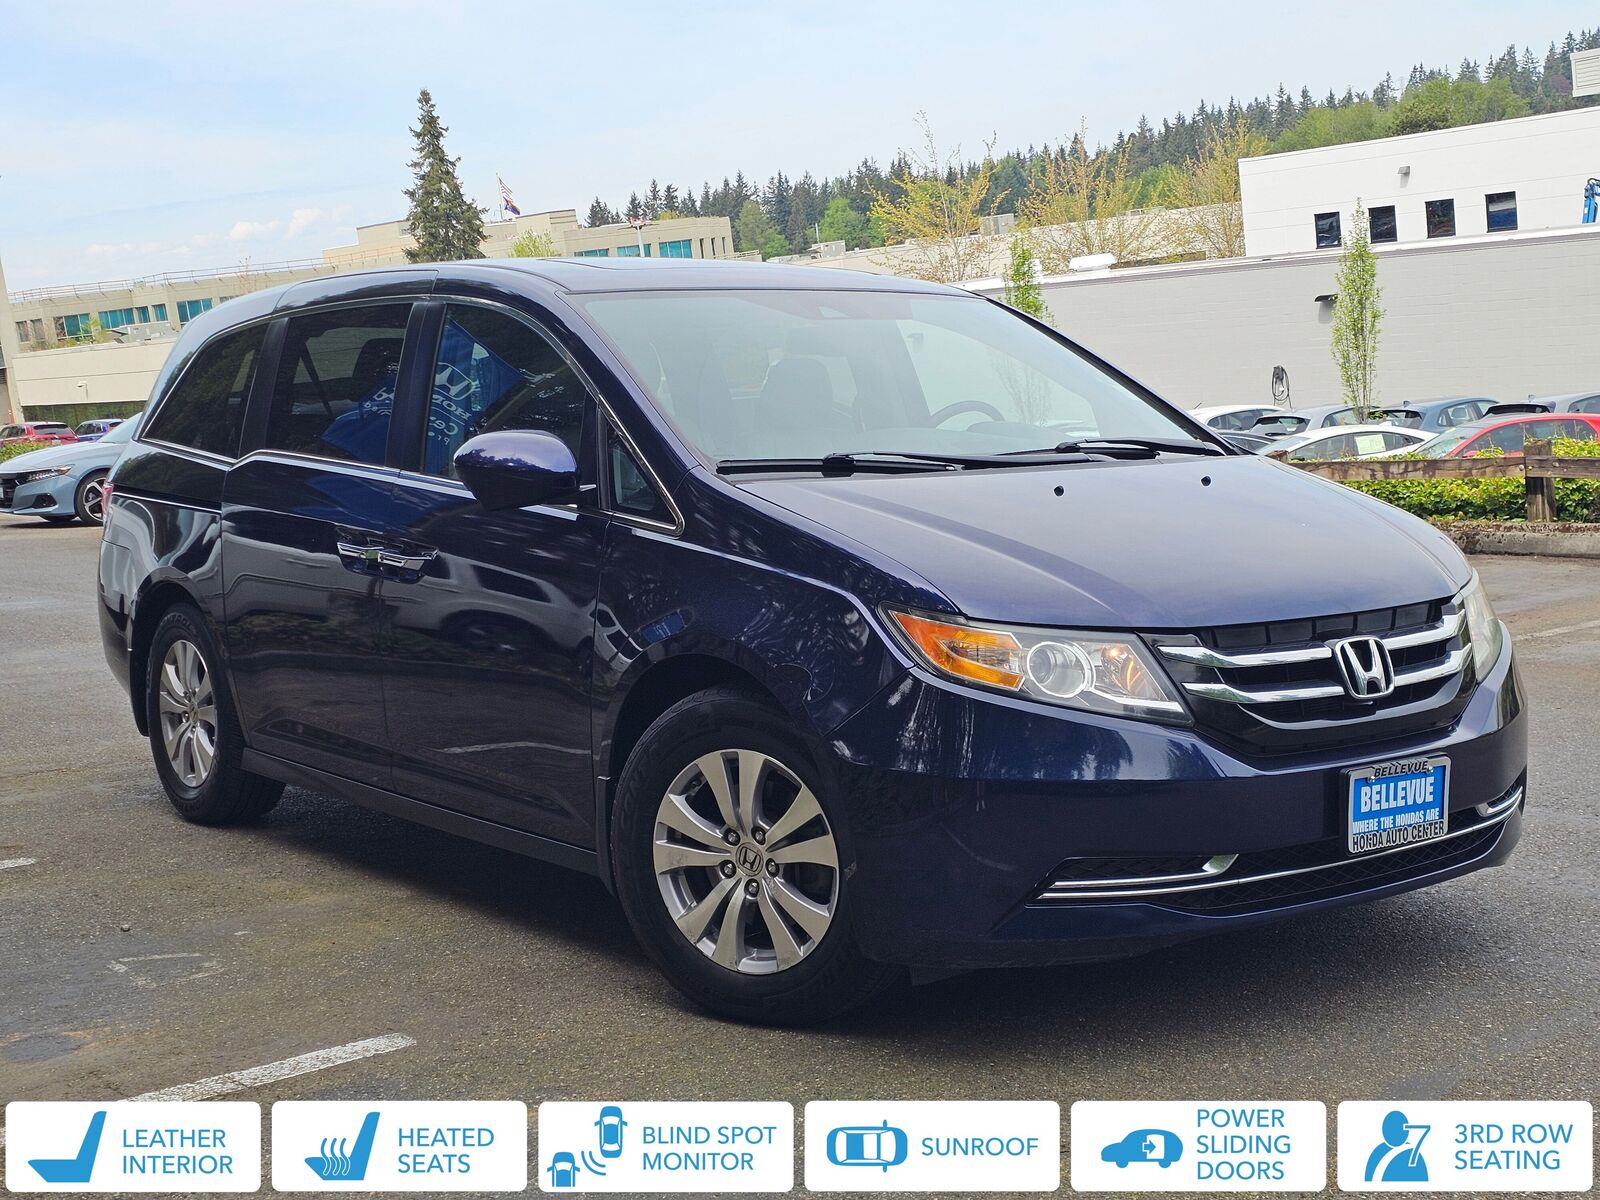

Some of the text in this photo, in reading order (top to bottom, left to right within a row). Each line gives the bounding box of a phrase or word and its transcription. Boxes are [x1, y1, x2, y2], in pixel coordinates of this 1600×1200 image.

[1374, 760, 1428, 778] BELLEVUE
[1360, 776, 1435, 813] BELLEVUE
[1353, 807, 1440, 834] WHERE THE HONDAS ARE
[1352, 820, 1445, 852] HONDA AUTO CENTER
